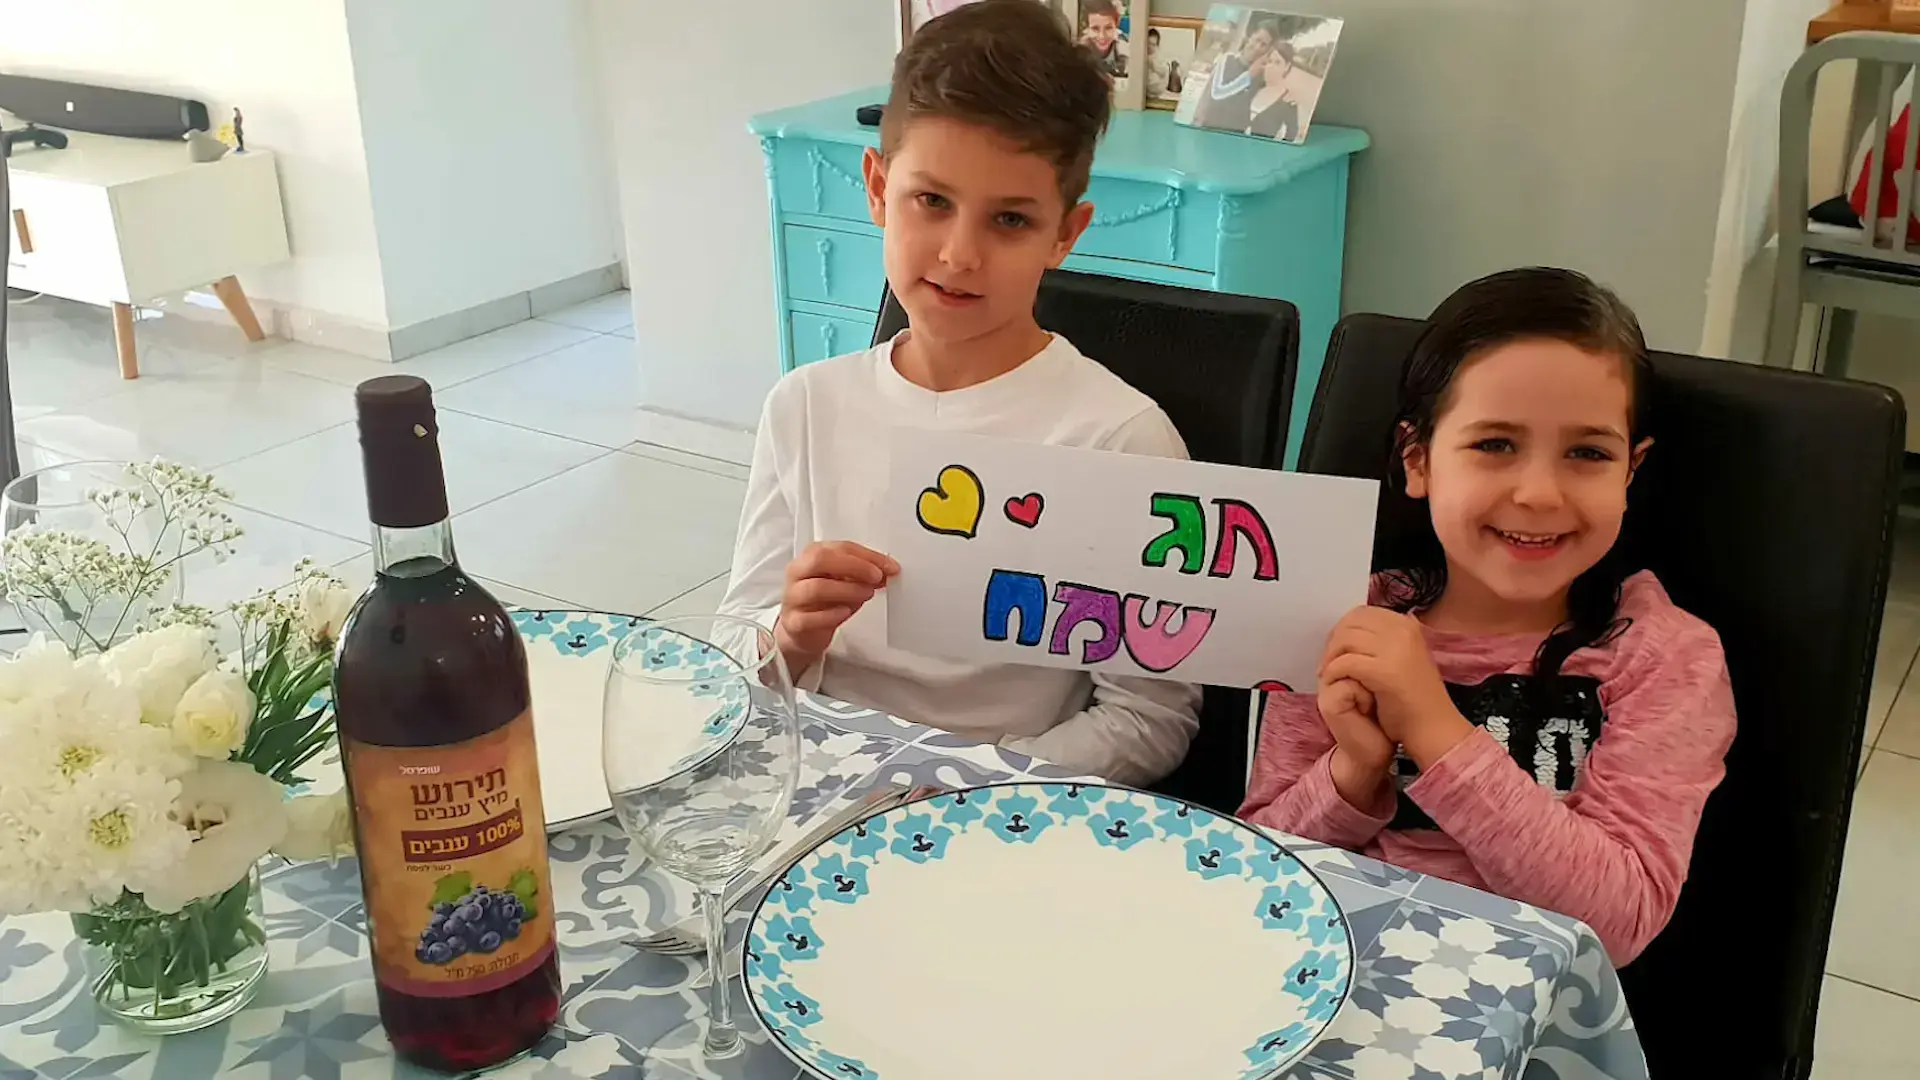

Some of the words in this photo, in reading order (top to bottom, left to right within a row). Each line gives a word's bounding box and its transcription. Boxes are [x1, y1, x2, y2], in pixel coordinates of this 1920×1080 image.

[1142, 492, 1280, 581] חג
[982, 568, 1217, 673] שמח
[410, 767, 505, 805] תירוש
[414, 803, 470, 821] ענבים
[478, 790, 508, 815] מיץ
[409, 835, 469, 854] ענבים
